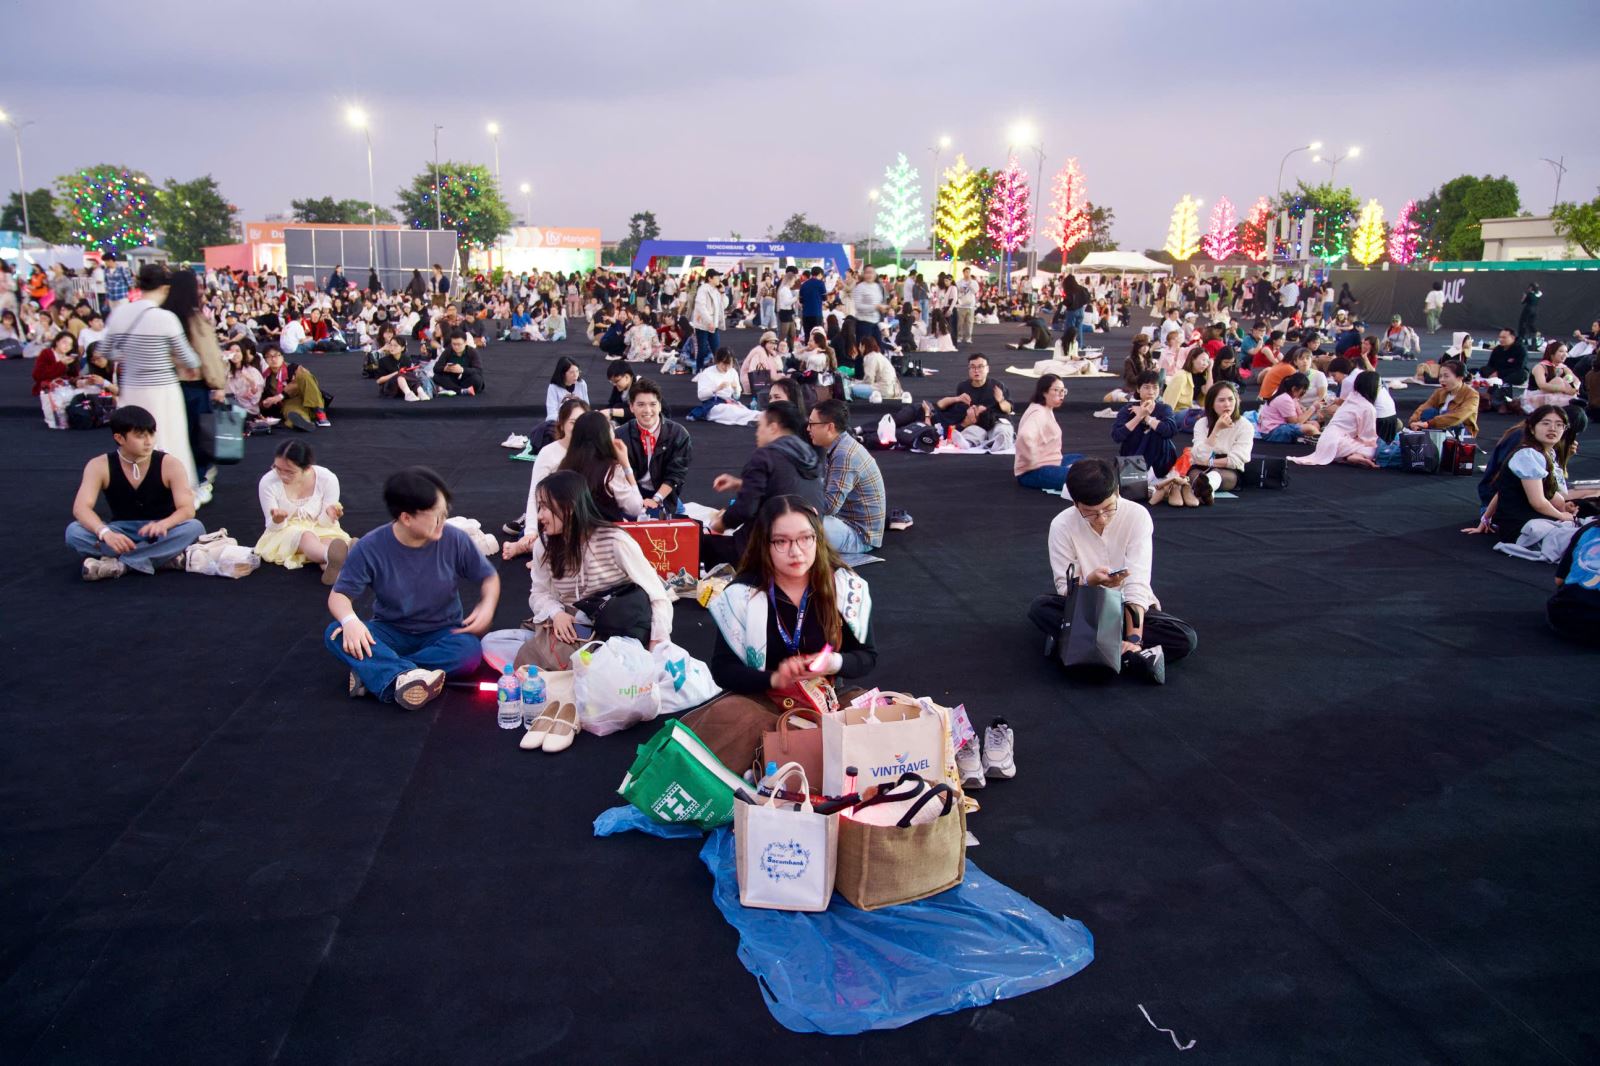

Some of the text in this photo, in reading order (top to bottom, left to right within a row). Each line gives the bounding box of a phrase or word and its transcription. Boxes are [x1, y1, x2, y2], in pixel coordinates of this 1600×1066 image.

[768, 244, 785, 252] VISA
[1442, 278, 1466, 303] WC
[869, 758, 931, 778] VINTRAVEL
